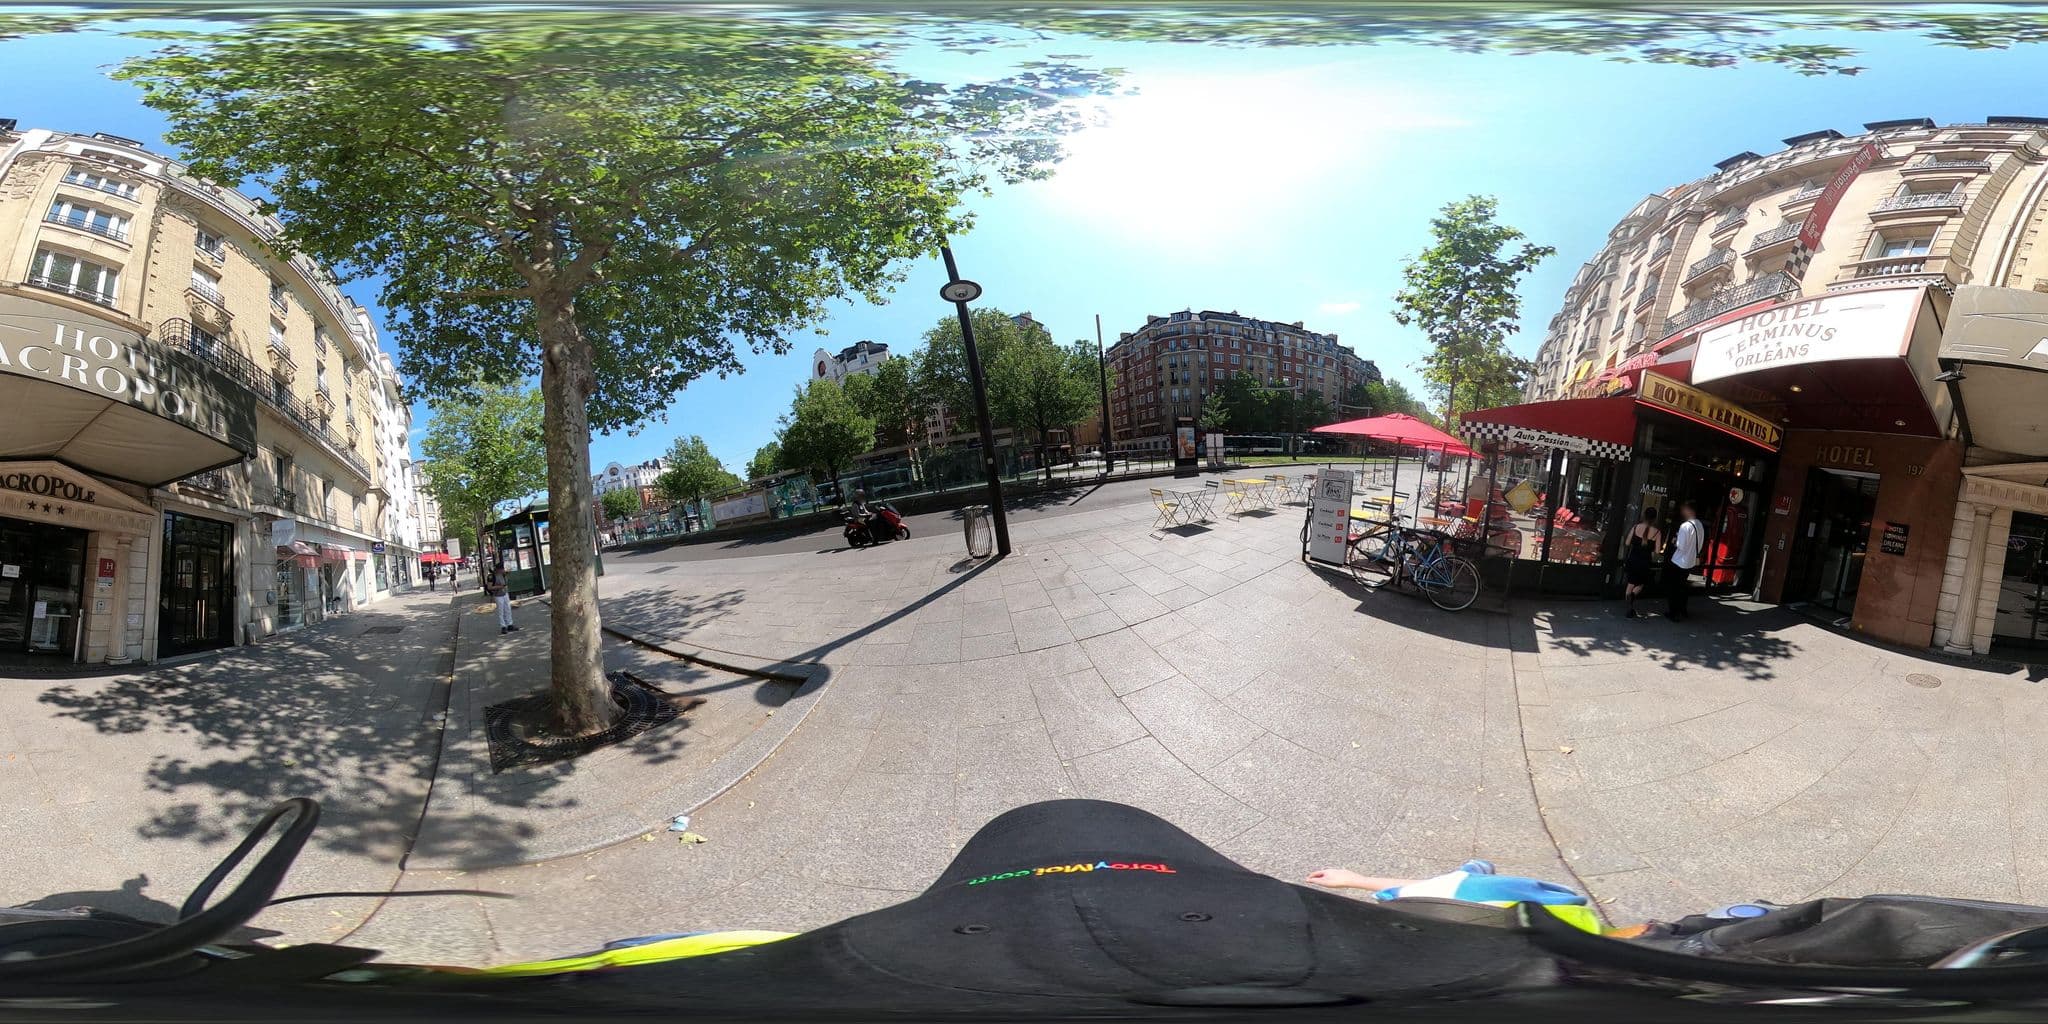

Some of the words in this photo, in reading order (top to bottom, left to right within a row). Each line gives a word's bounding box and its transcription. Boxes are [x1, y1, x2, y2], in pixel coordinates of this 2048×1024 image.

[1738, 299, 1830, 333] HOTEL
[54, 323, 182, 388] HOTEL
[1726, 323, 1837, 360] TERMINUS
[1513, 430, 1535, 441] Auto
[1536, 434, 1570, 447] Passion
[1707, 405, 1769, 440] TERMINUS
[1817, 446, 1875, 467] HOTEL
[967, 861, 1177, 887] ToroyMoi.com
